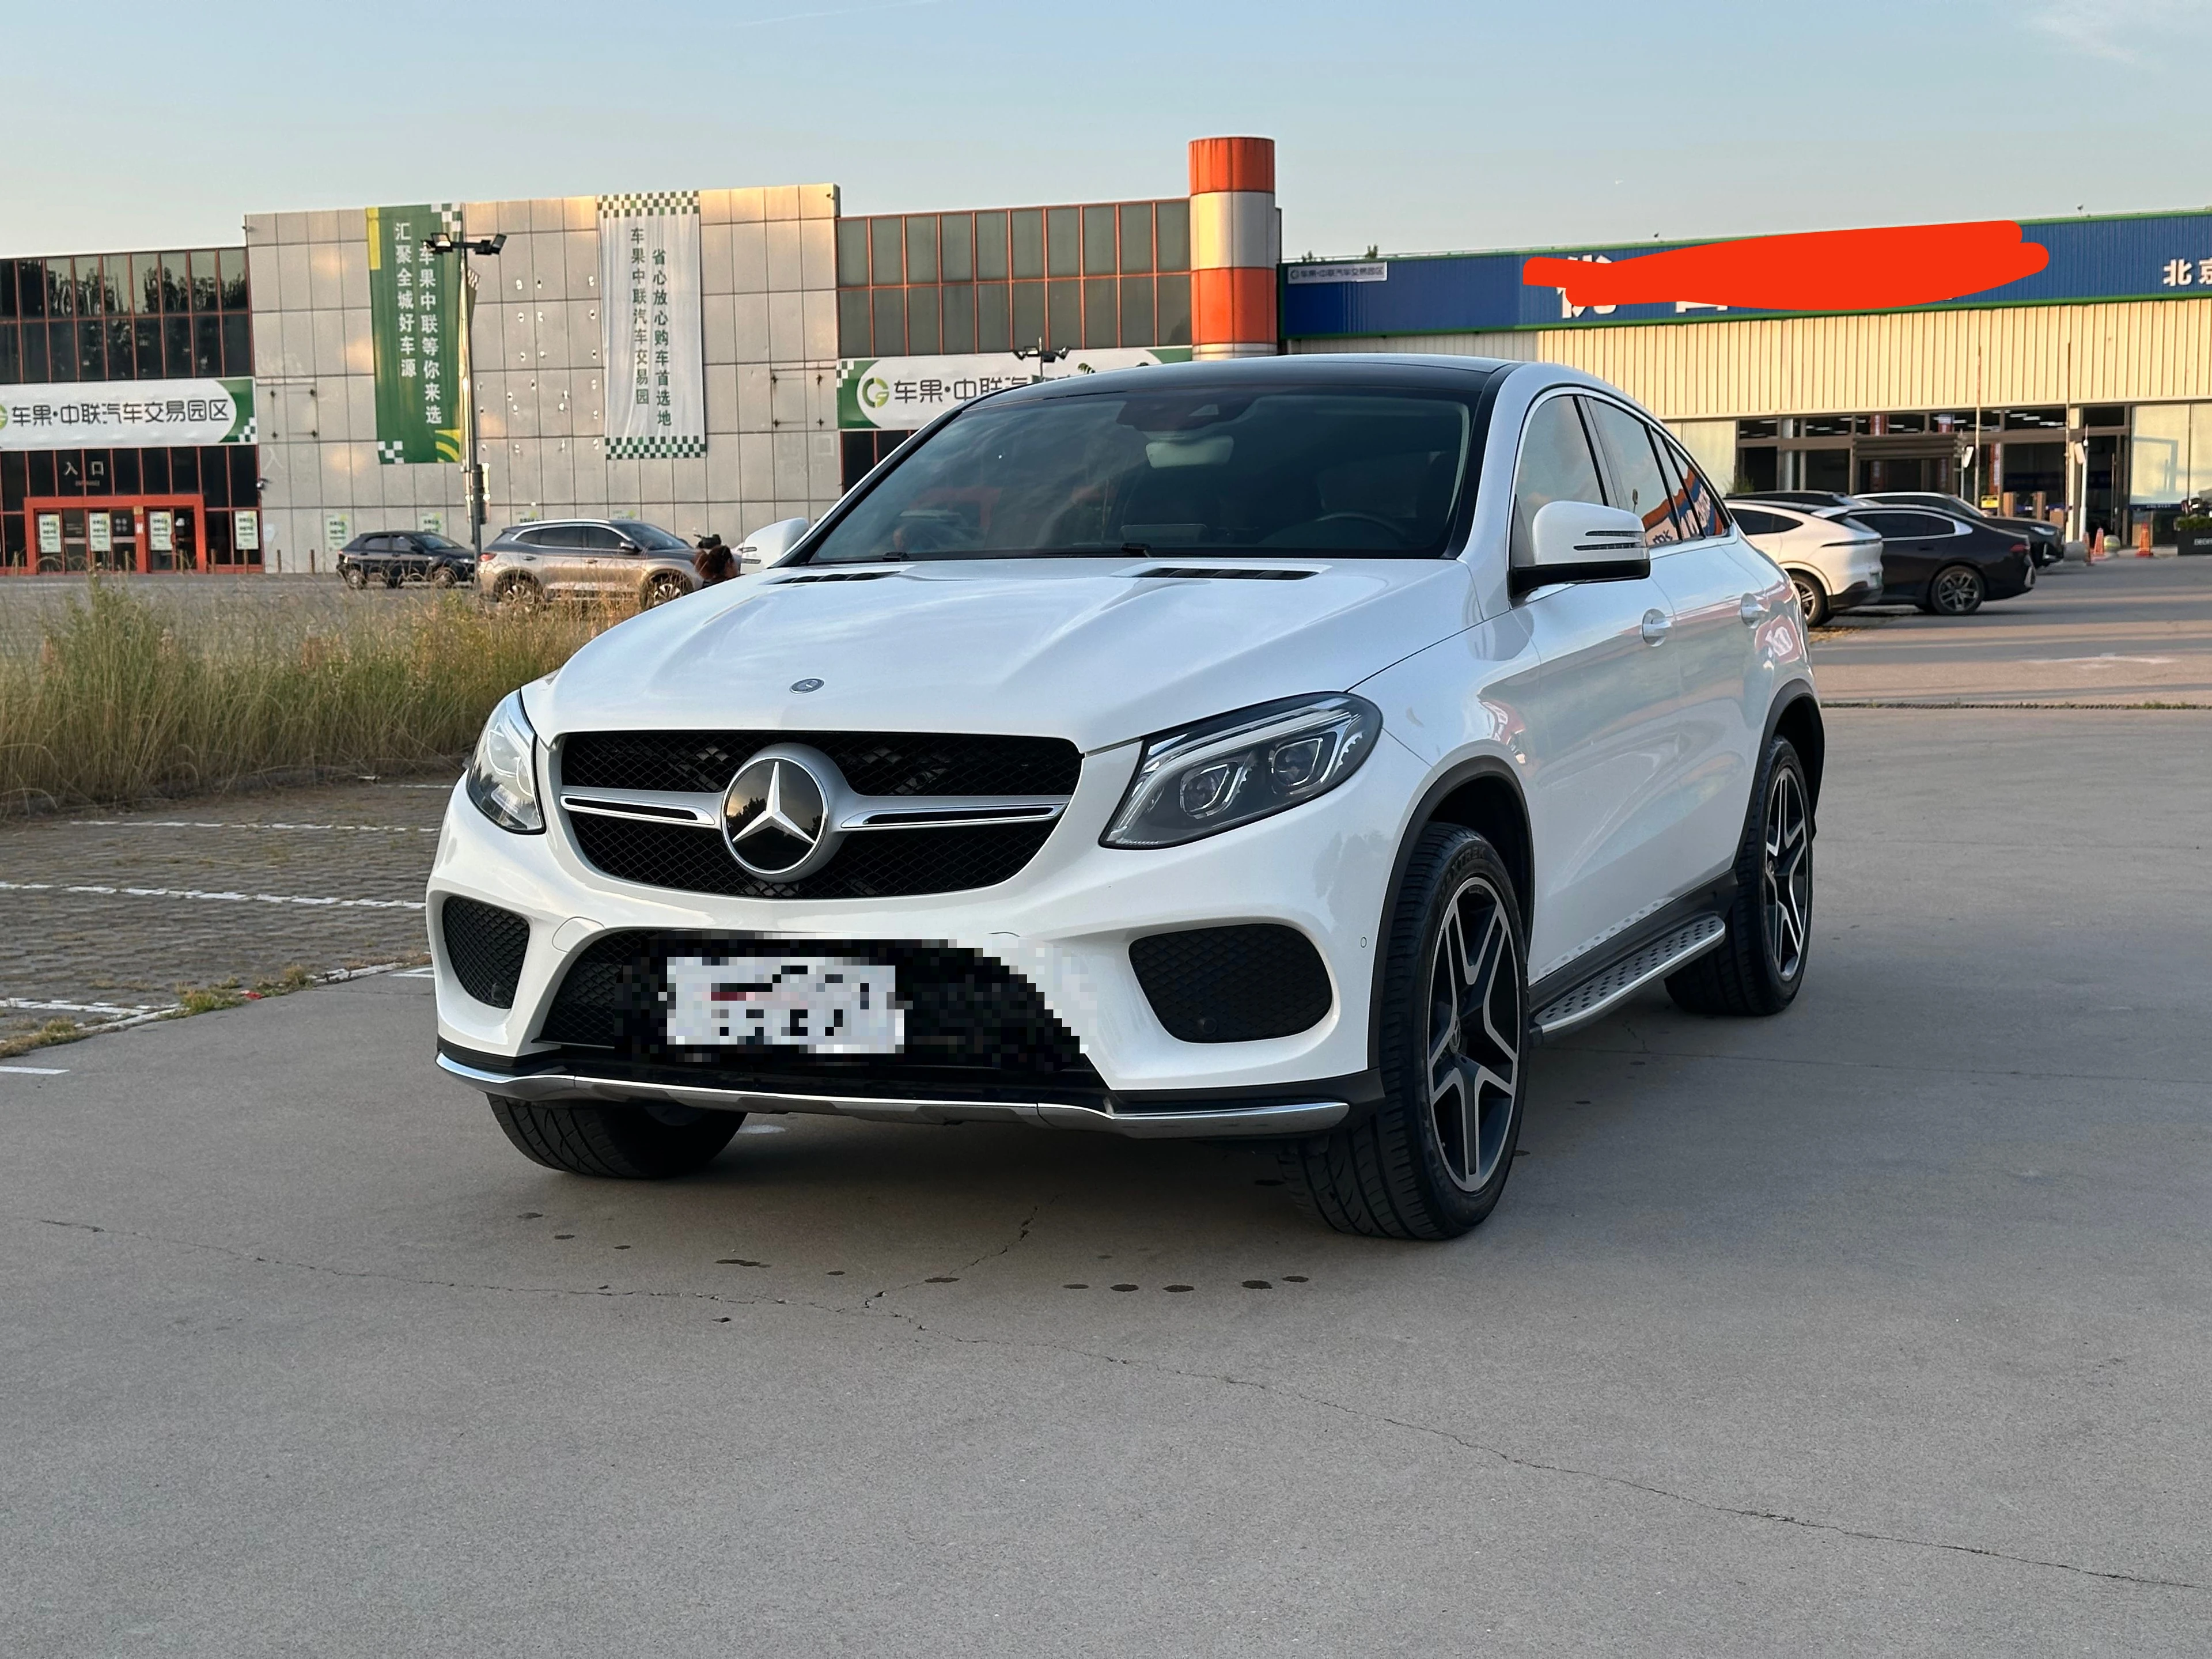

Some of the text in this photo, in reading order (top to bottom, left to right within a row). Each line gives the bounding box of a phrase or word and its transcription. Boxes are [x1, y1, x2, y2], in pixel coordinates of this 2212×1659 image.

[395, 222, 416, 377] 汇聚全城好车源
[419, 244, 442, 425] 车果中联等你来选
[631, 228, 649, 404] 车果中联汽车交易园
[652, 249, 672, 427] 省心放心购车首选地
[12, 399, 229, 427] 车果·中联汽车交易园区
[64, 461, 104, 476] 入口
